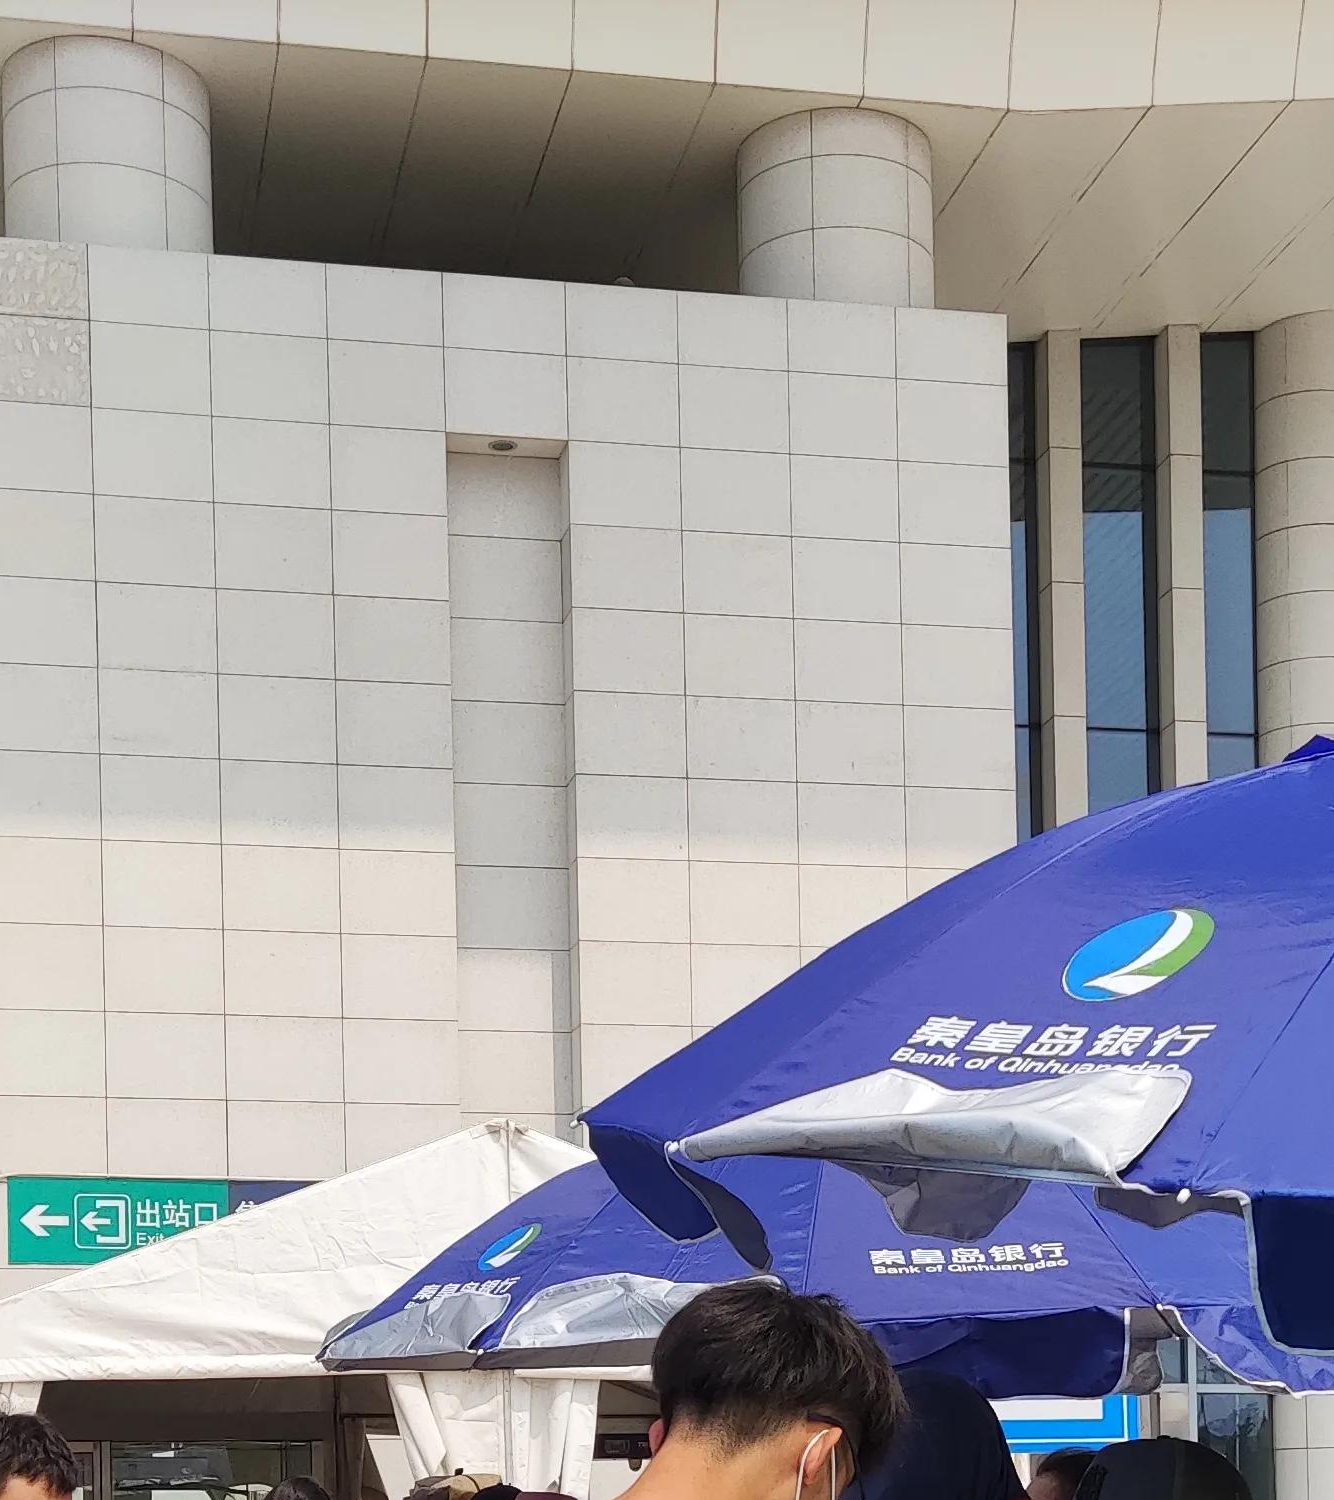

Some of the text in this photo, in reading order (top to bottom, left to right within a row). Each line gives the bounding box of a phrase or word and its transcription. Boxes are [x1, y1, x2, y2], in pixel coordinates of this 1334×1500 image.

[906, 1015, 1217, 1058] 秦皇岛银行
[890, 1046, 962, 1068] Bank
[964, 1055, 997, 1071] of
[136, 1199, 217, 1228] 出站口
[869, 1242, 1065, 1265] 秦皇岛银行
[873, 1259, 1069, 1274] Bank of Qinhuangdao
